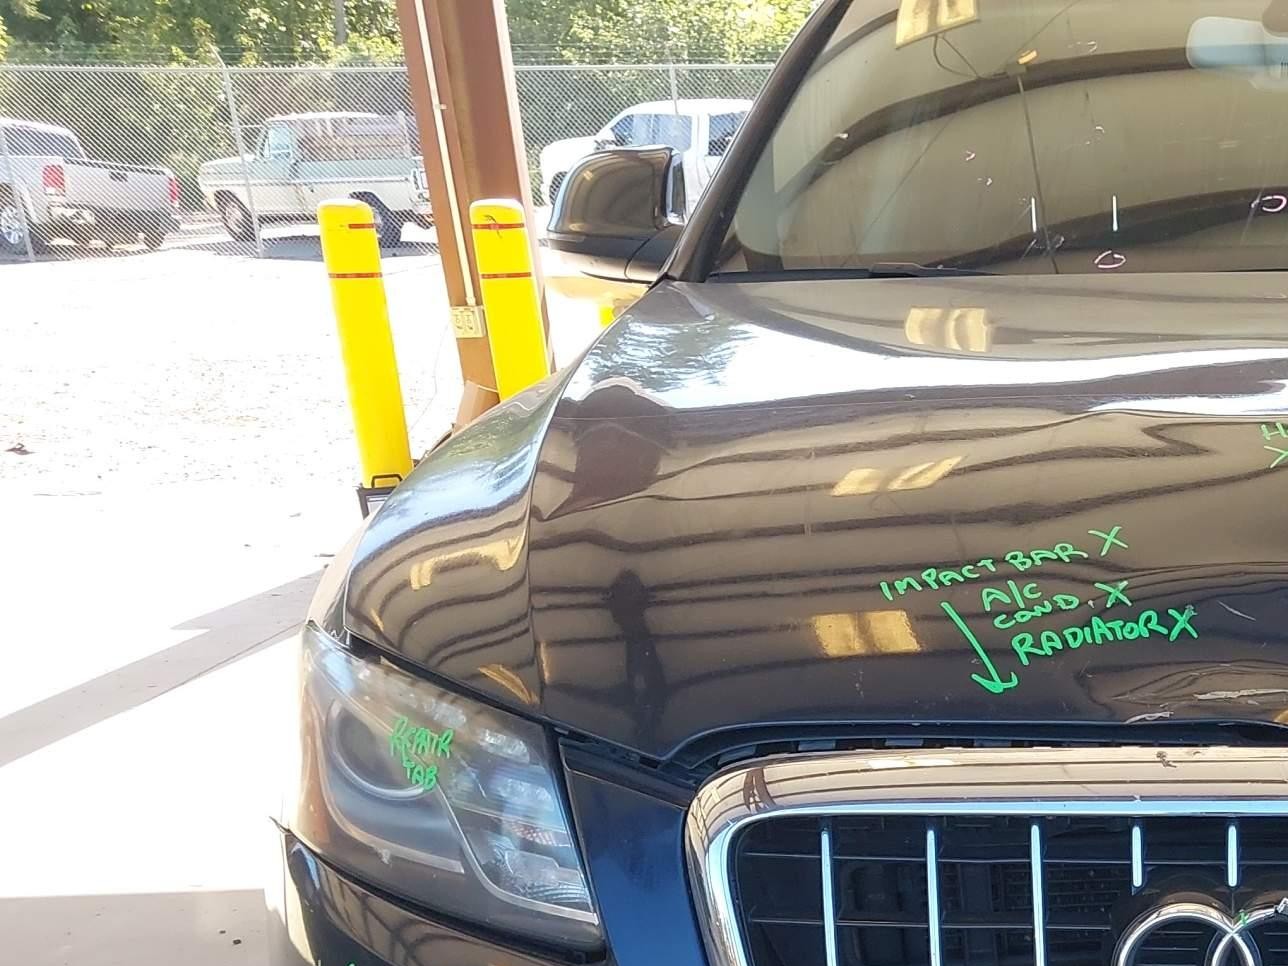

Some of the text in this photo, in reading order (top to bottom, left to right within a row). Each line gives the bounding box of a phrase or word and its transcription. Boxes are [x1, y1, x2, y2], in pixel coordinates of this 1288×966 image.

[879, 525, 1129, 601] IMPACT BAR X
[980, 579, 1042, 612] A/C
[1094, 580, 1133, 608] X
[1011, 608, 1169, 666] RADIATOR
[403, 761, 438, 791] TAB
